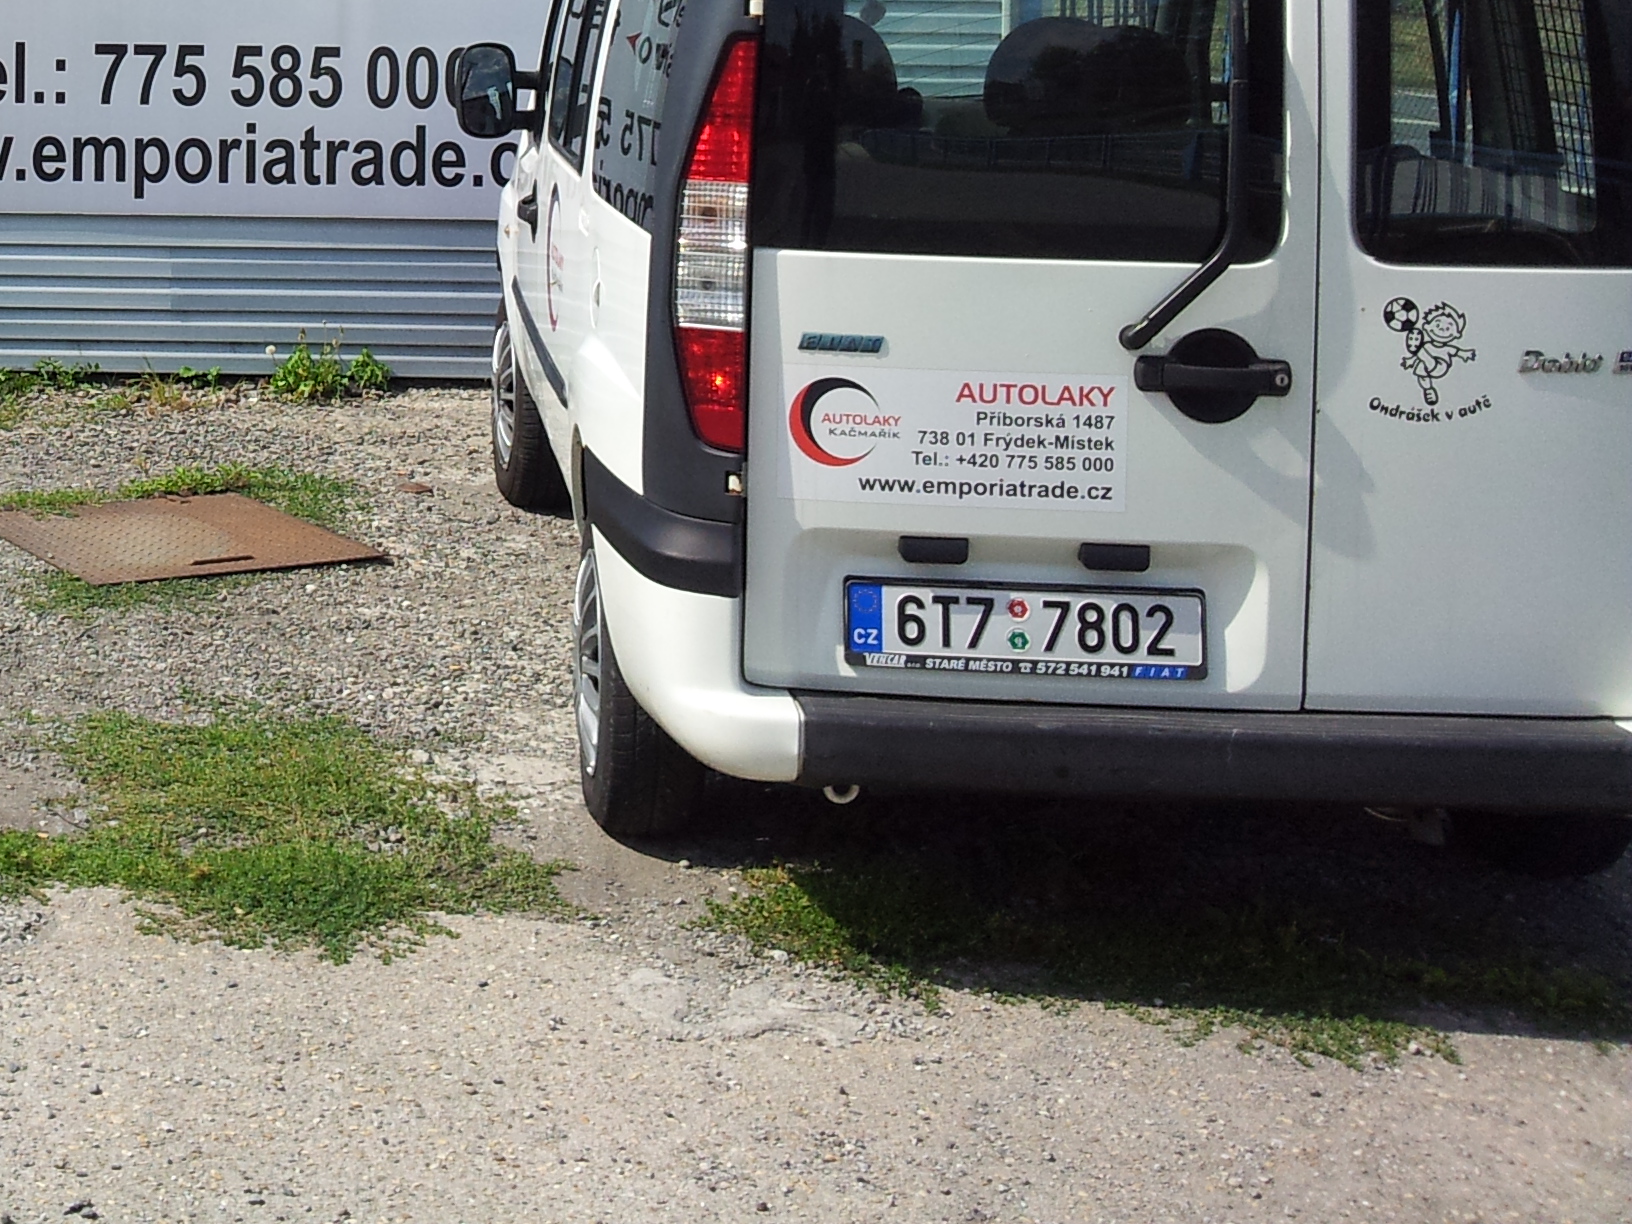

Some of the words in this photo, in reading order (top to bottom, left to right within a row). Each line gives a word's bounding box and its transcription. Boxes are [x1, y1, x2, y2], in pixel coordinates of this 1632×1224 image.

[94, 43, 207, 107] 775
[230, 45, 343, 108] 585
[800, 333, 884, 353] FIAT
[955, 381, 1115, 408] AUTOLAKY
[821, 412, 902, 427] AUTOLAKY
[1369, 396, 1441, 423] Ondrášek
[1444, 411, 1455, 421] v
[1458, 394, 1492, 419] autě
[976, 411, 1066, 429] Příborská
[1072, 414, 1115, 430] 1487
[828, 426, 901, 440] KAČMAŘÍK
[917, 430, 950, 446] 738
[955, 431, 976, 446] 01
[983, 433, 1115, 452] Frýdek-Místek
[912, 451, 949, 467] Tel.:
[956, 453, 999, 469] +420
[1006, 454, 1039, 470] 775
[1044, 456, 1077, 471] 585
[1082, 457, 1115, 473] 000
[858, 477, 1114, 500] www.emporiatrade.cz
[853, 628, 878, 645] CZ
[897, 594, 995, 649] 6T7
[1042, 600, 1176, 657] 7802
[925, 657, 966, 671] STARÉ
[968, 657, 1013, 672] MĚSTO
[1036, 661, 1066, 675] 572
[1069, 663, 1097, 676] 541
[1100, 664, 1128, 677] 941
[1134, 666, 1185, 678] FIAT
